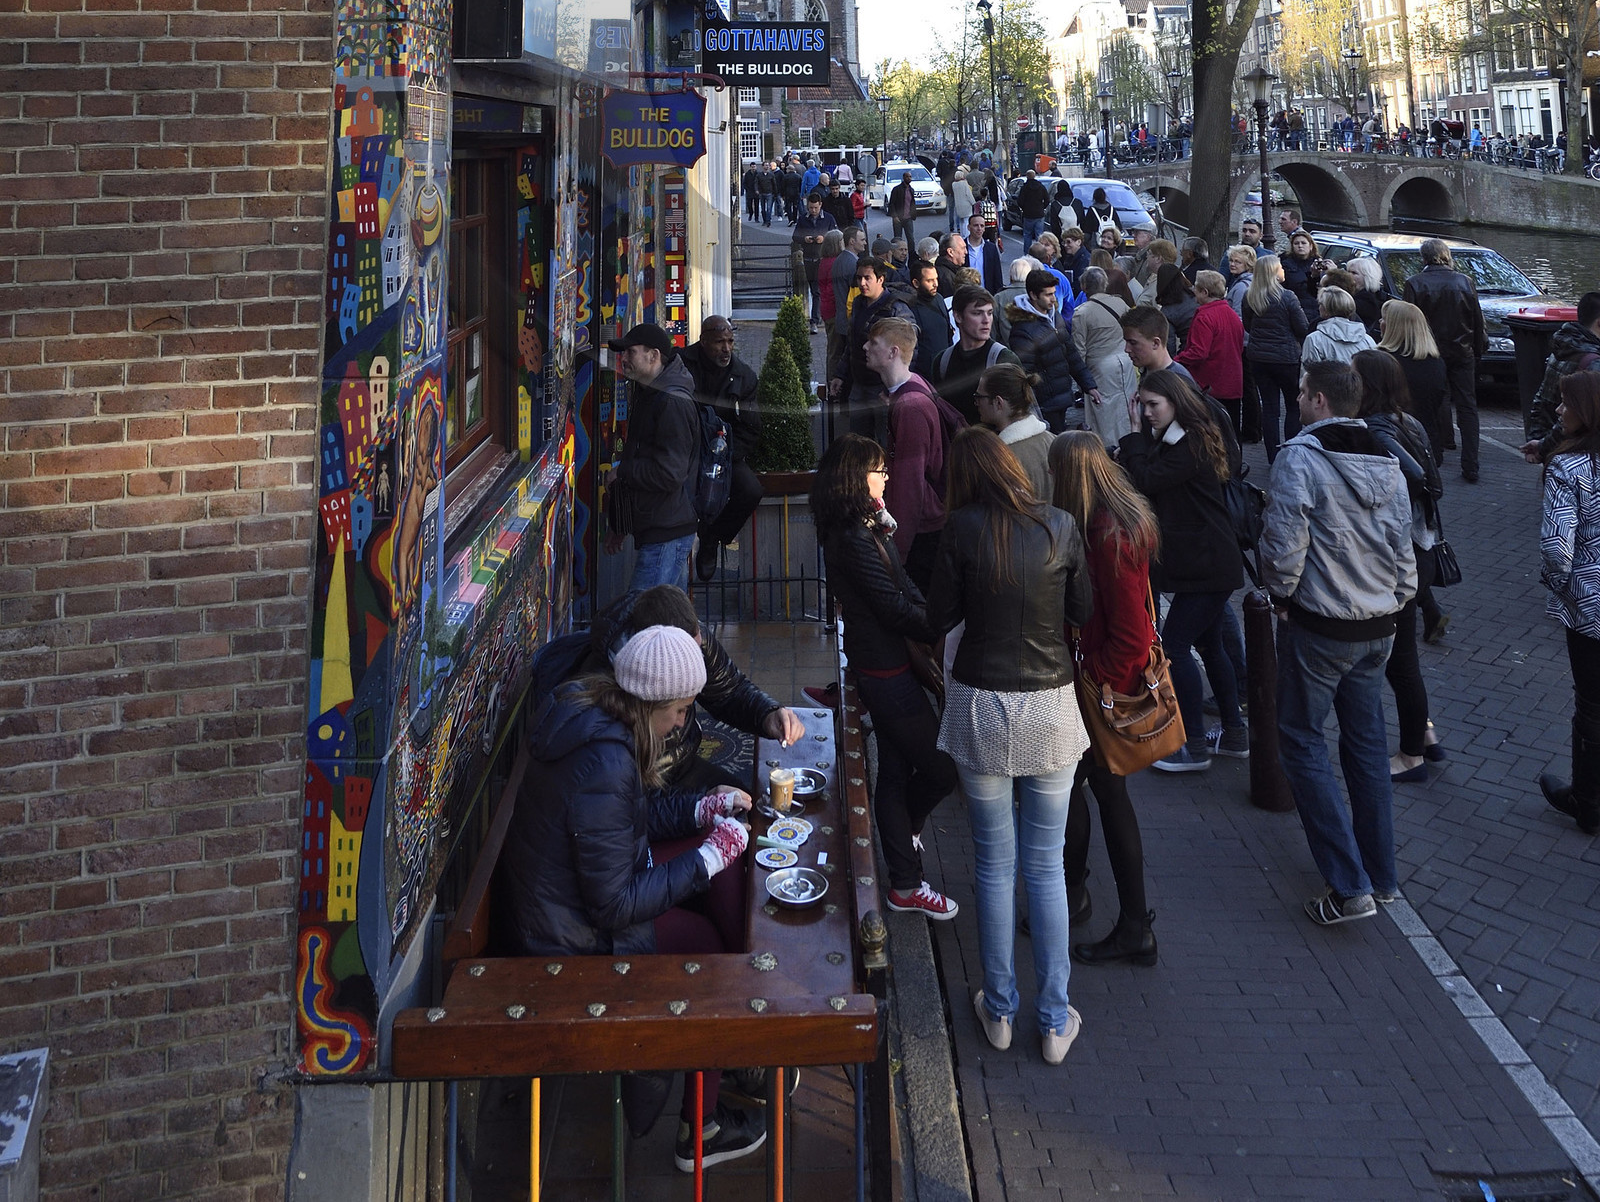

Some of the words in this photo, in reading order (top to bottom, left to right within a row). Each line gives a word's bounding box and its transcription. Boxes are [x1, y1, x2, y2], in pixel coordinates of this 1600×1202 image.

[705, 28, 825, 52] GOTTAHAVES
[717, 63, 744, 75] THE
[748, 63, 813, 75] BULLDOG
[639, 107, 670, 122] THE
[610, 128, 694, 149] BULLDOG
